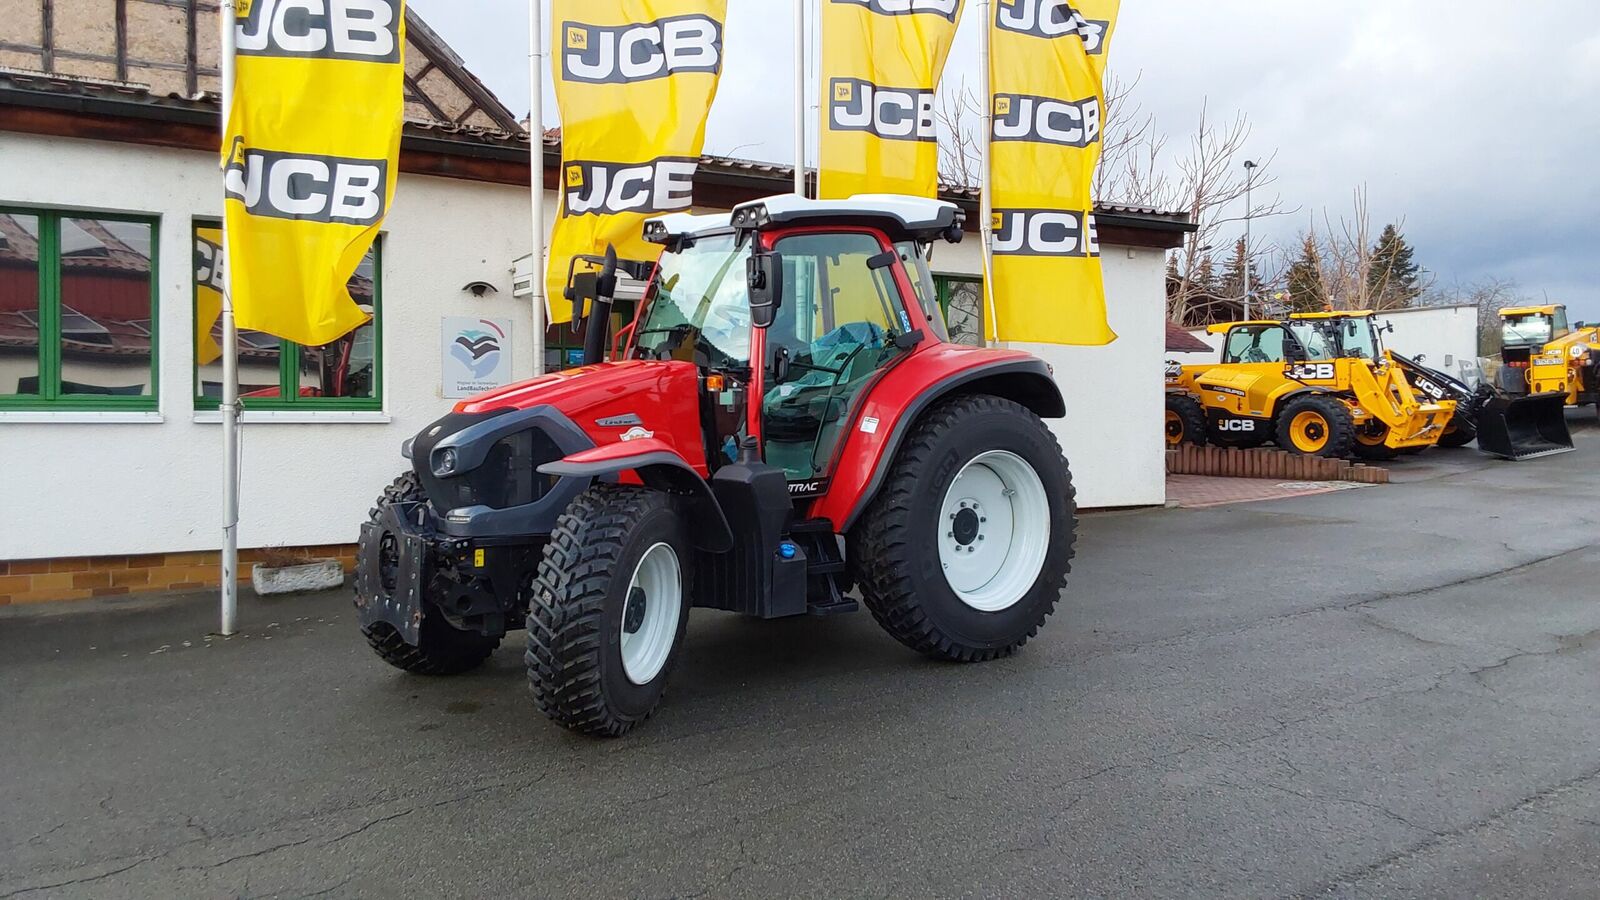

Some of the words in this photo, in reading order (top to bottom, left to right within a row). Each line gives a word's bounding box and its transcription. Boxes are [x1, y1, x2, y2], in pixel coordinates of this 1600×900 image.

[235, 0, 394, 56] JCB
[567, 19, 718, 79] JCB
[994, 98, 1100, 143] JCB
[225, 154, 381, 219] JCB
[1414, 377, 1443, 399] JCB
[1218, 419, 1255, 431] JCB
[788, 482, 819, 493] TRAC
